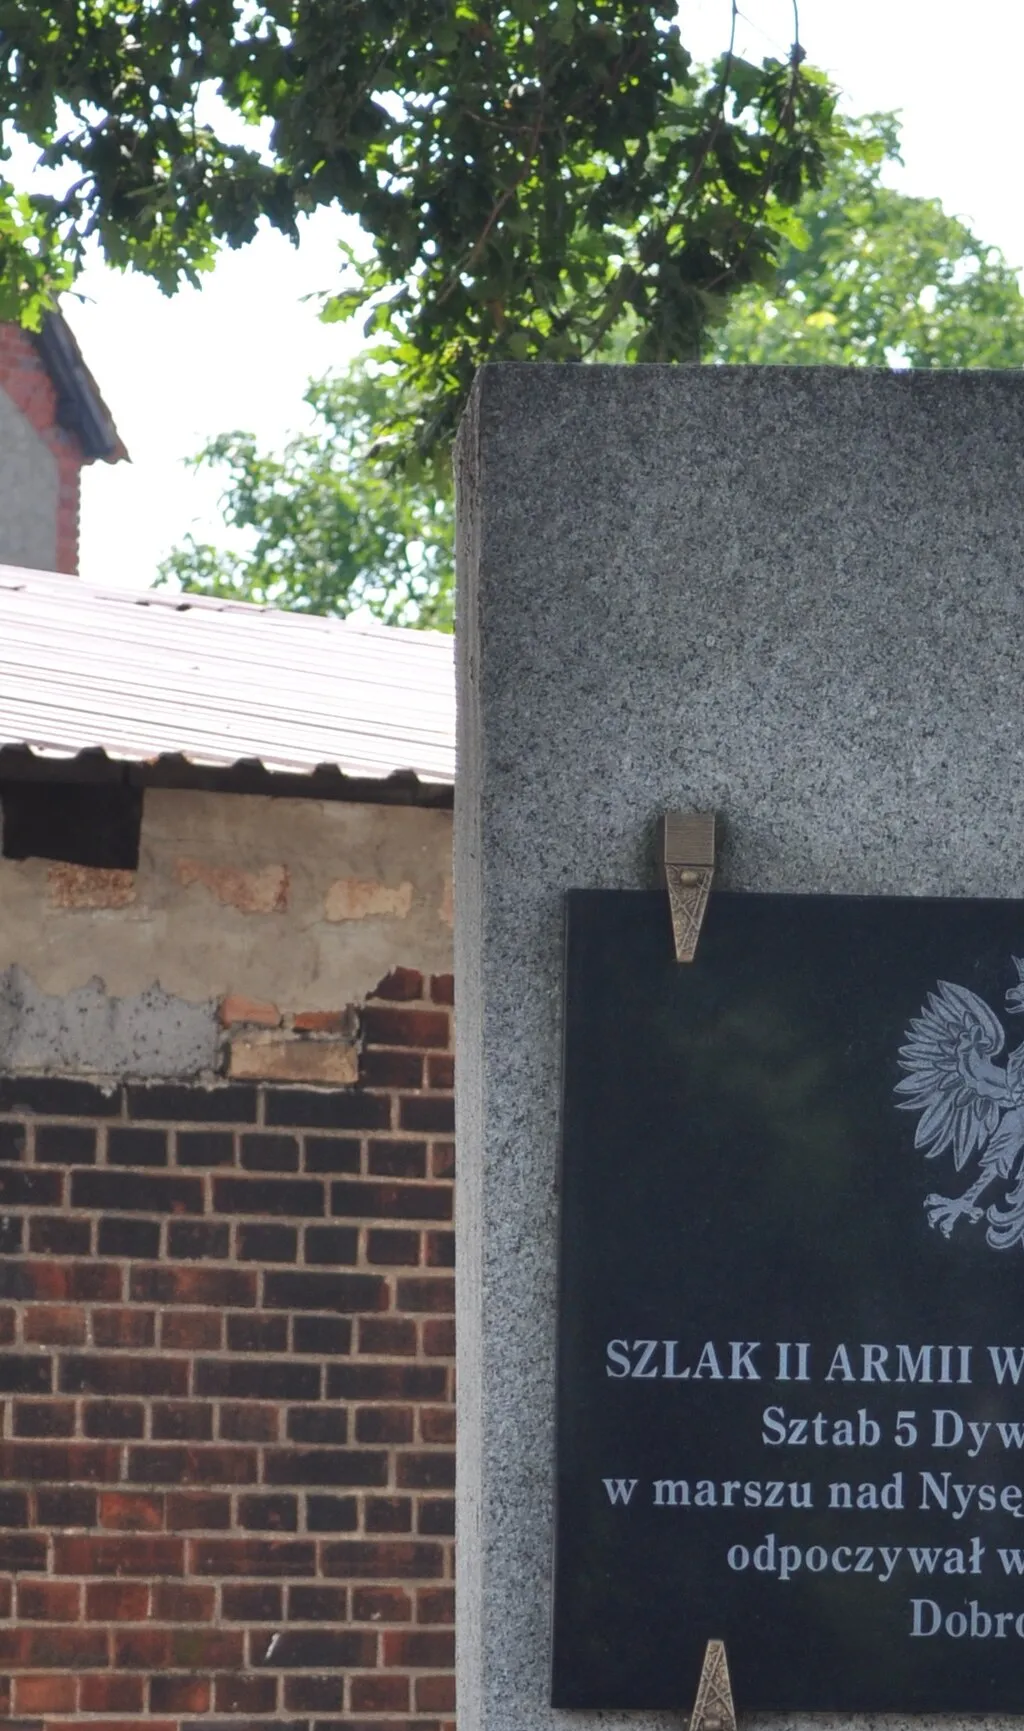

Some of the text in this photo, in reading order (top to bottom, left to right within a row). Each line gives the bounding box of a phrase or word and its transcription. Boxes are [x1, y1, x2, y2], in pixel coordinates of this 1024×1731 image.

[606, 1339, 762, 1380] SZLAK
[775, 1342, 811, 1381] II
[824, 1343, 973, 1384] ARMII
[761, 1405, 881, 1447] Sztab
[894, 1410, 918, 1448] 5
[602, 1478, 639, 1505] w
[652, 1479, 814, 1508] marszu
[828, 1471, 905, 1510] nad
[918, 1471, 1024, 1520] Nysę
[727, 1533, 986, 1583] odpoczywał
